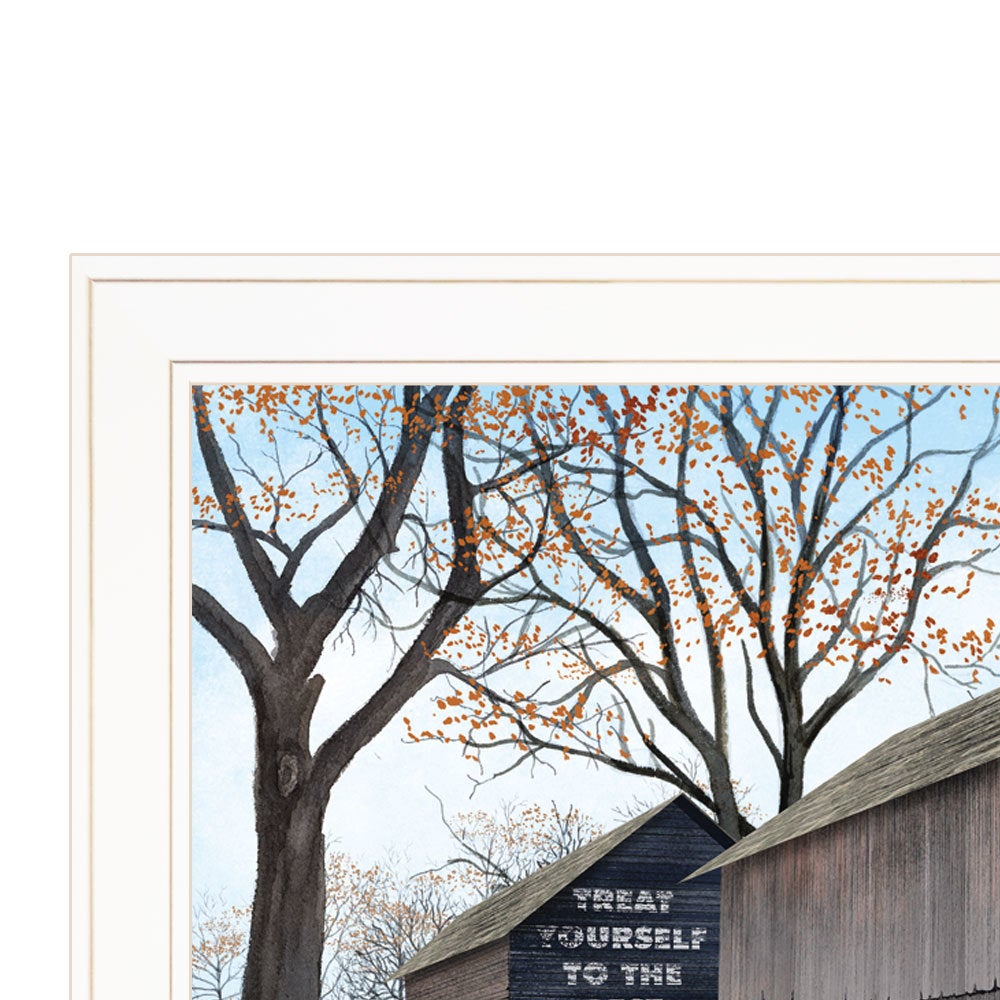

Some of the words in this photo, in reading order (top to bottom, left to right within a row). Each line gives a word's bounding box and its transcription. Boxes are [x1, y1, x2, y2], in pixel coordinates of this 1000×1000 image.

[572, 887, 674, 914] TREAT
[536, 925, 707, 950] YOURSELF
[562, 962, 609, 986] TO
[620, 963, 683, 986] THE
